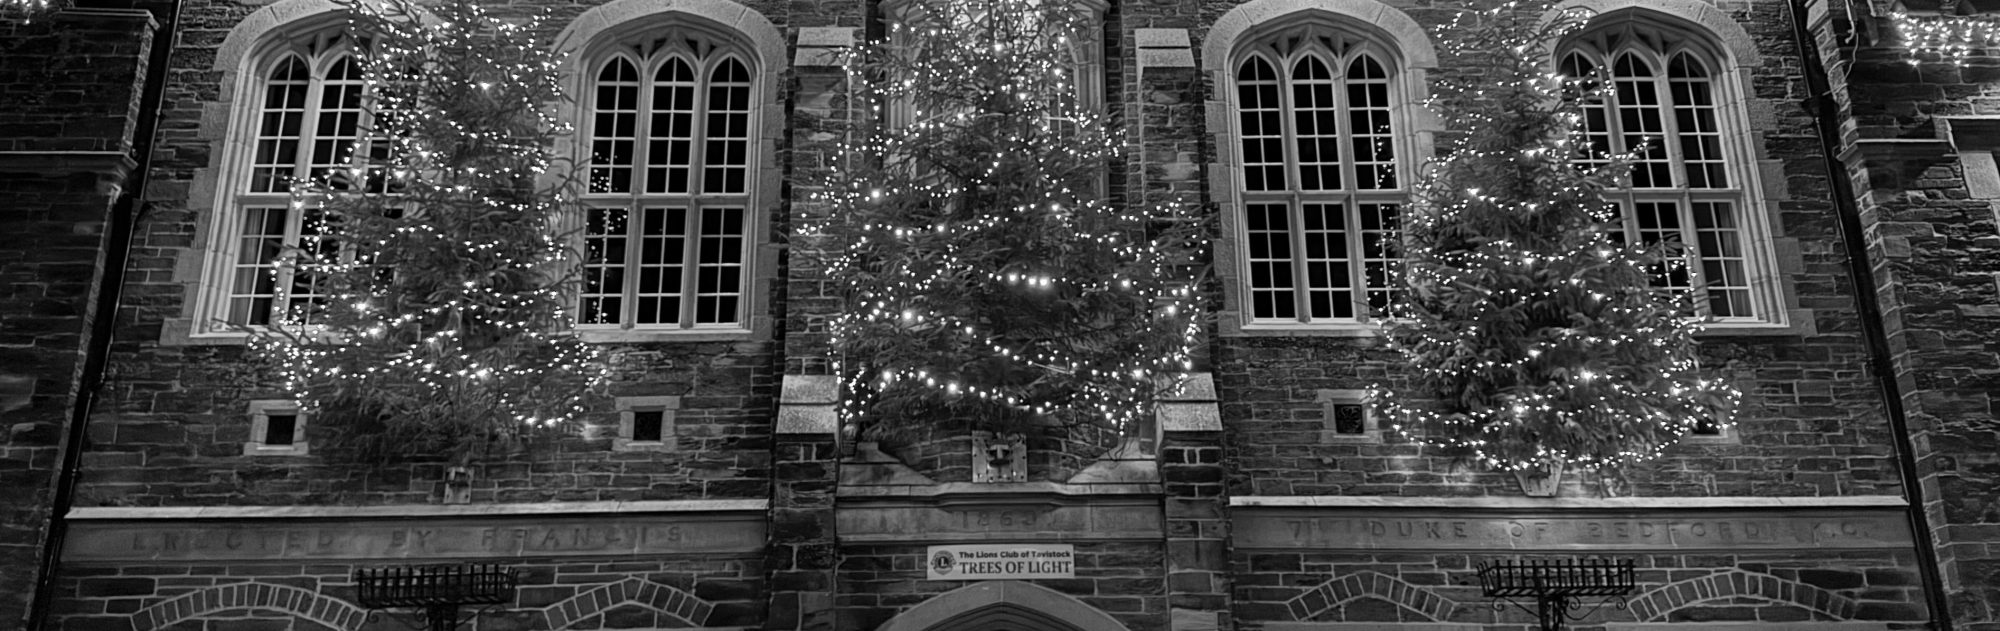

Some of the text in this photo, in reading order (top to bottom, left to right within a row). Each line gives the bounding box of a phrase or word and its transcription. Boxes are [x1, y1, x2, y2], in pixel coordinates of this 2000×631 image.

[392, 528, 432, 548] BY
[1370, 520, 1468, 541] DUKE
[1508, 520, 1550, 541] OF
[959, 560, 1072, 574] TREES OF LIGHT
